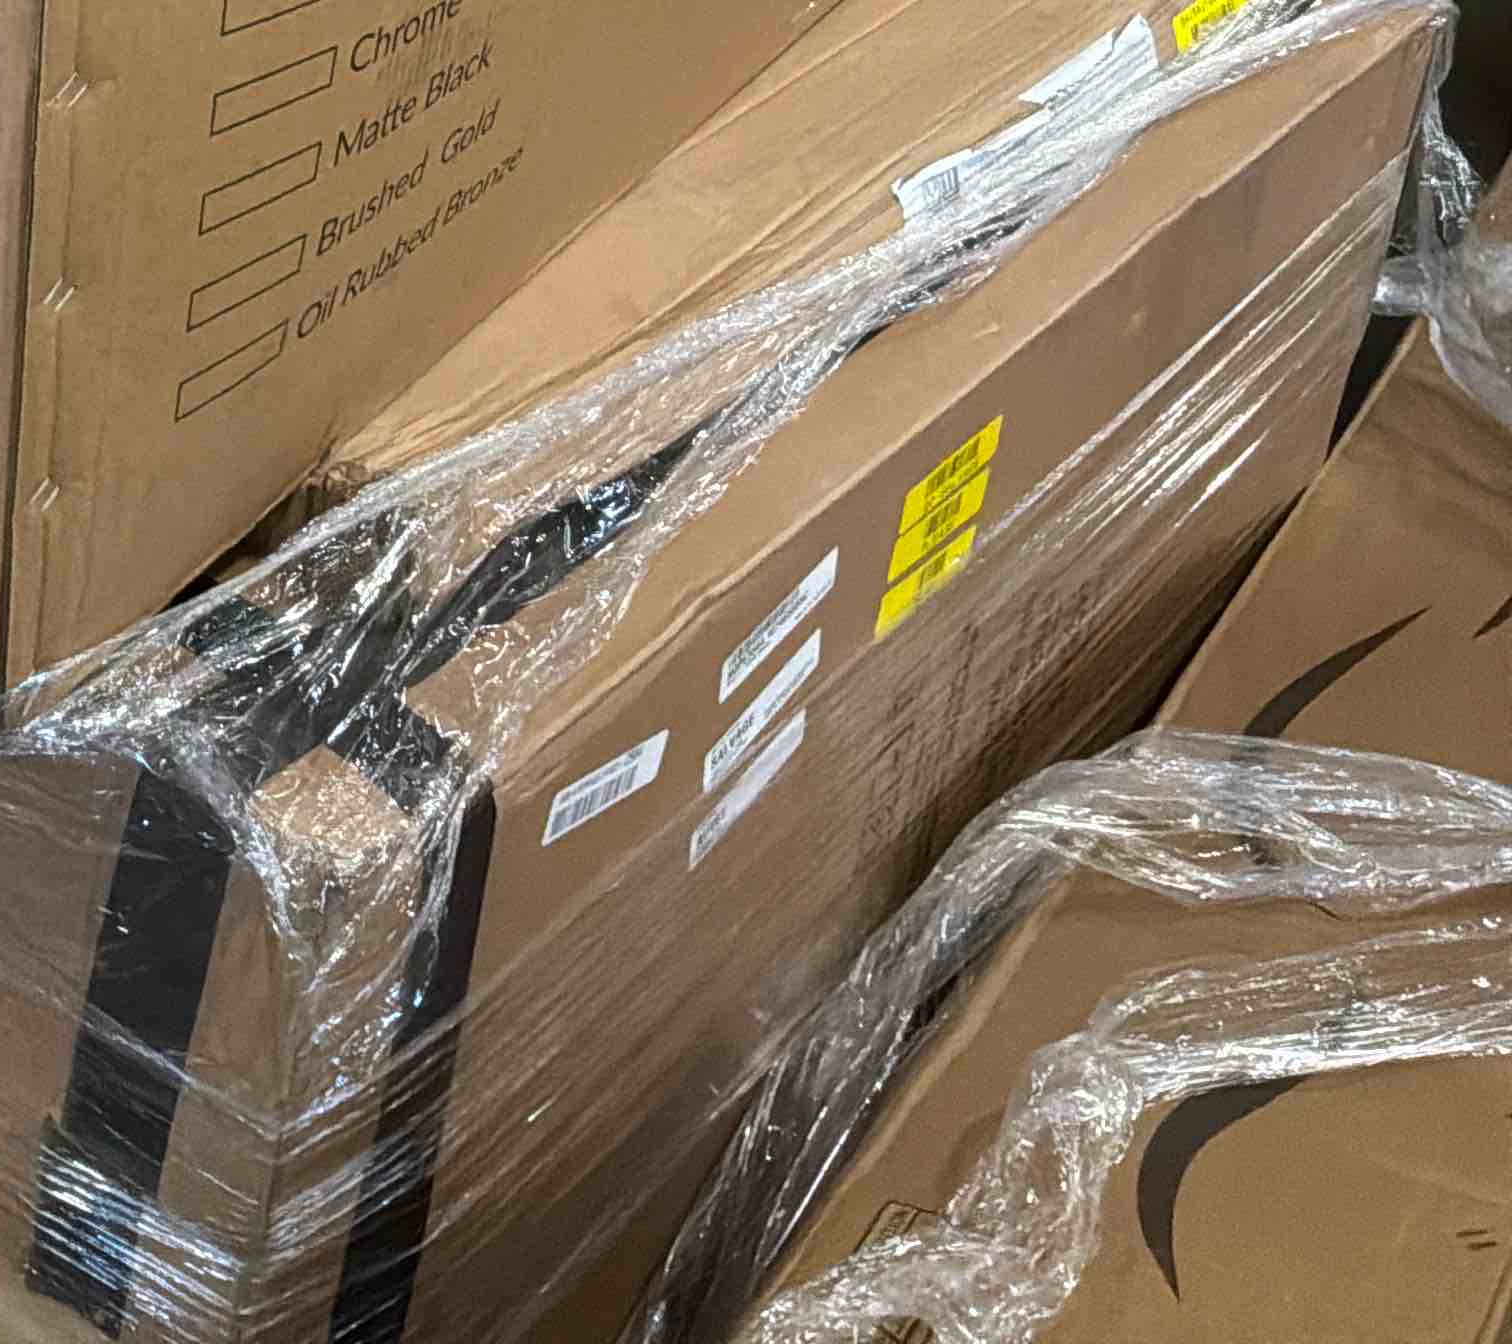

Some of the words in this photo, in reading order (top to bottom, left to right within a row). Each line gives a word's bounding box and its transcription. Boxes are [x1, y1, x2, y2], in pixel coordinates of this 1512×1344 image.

[315, 155, 428, 257] Brushed
[439, 98, 502, 164] Gold
[332, 95, 417, 169] Matte
[424, 41, 493, 98] Black
[296, 288, 338, 340] Oil
[341, 216, 438, 303] Rubbed
[442, 146, 524, 223] Bronze
